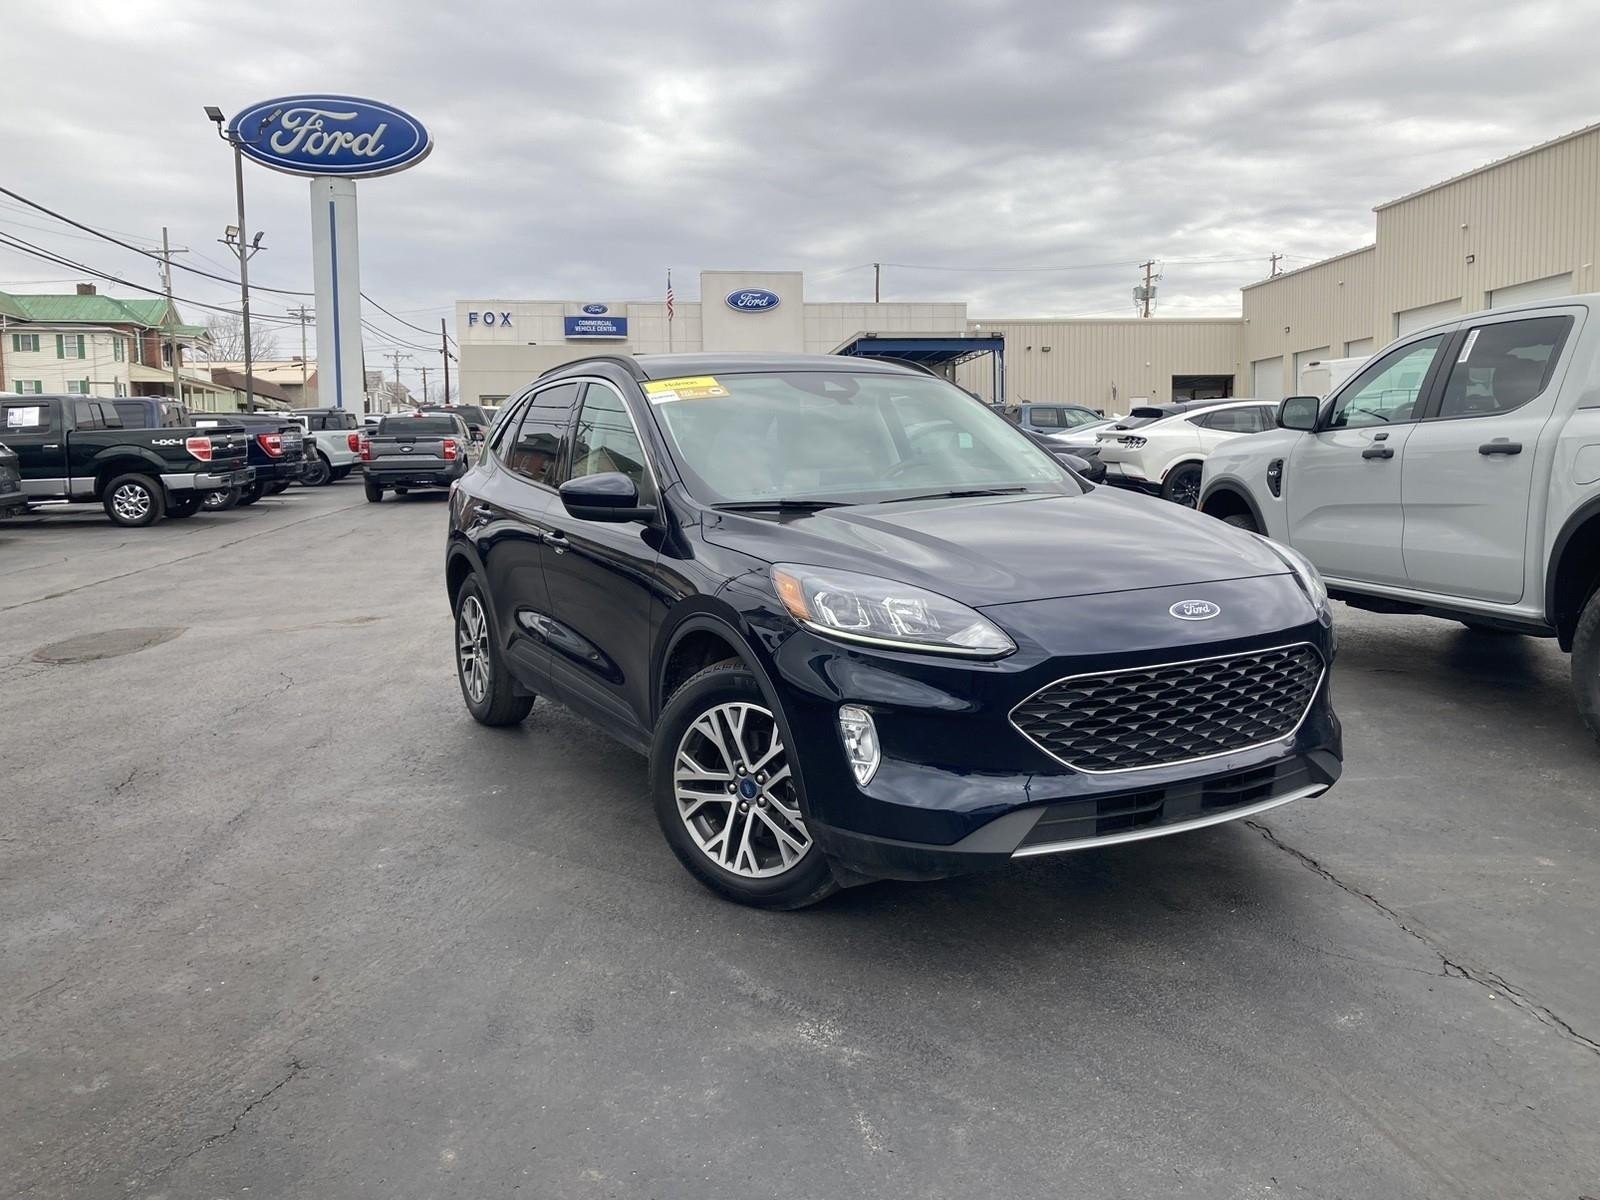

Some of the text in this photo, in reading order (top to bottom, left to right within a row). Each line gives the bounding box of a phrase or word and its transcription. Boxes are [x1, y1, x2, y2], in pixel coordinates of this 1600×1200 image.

[270, 107, 387, 157] Ford
[737, 292, 769, 306] Ford
[468, 311, 512, 327] FOX
[1183, 602, 1211, 615] Ford
